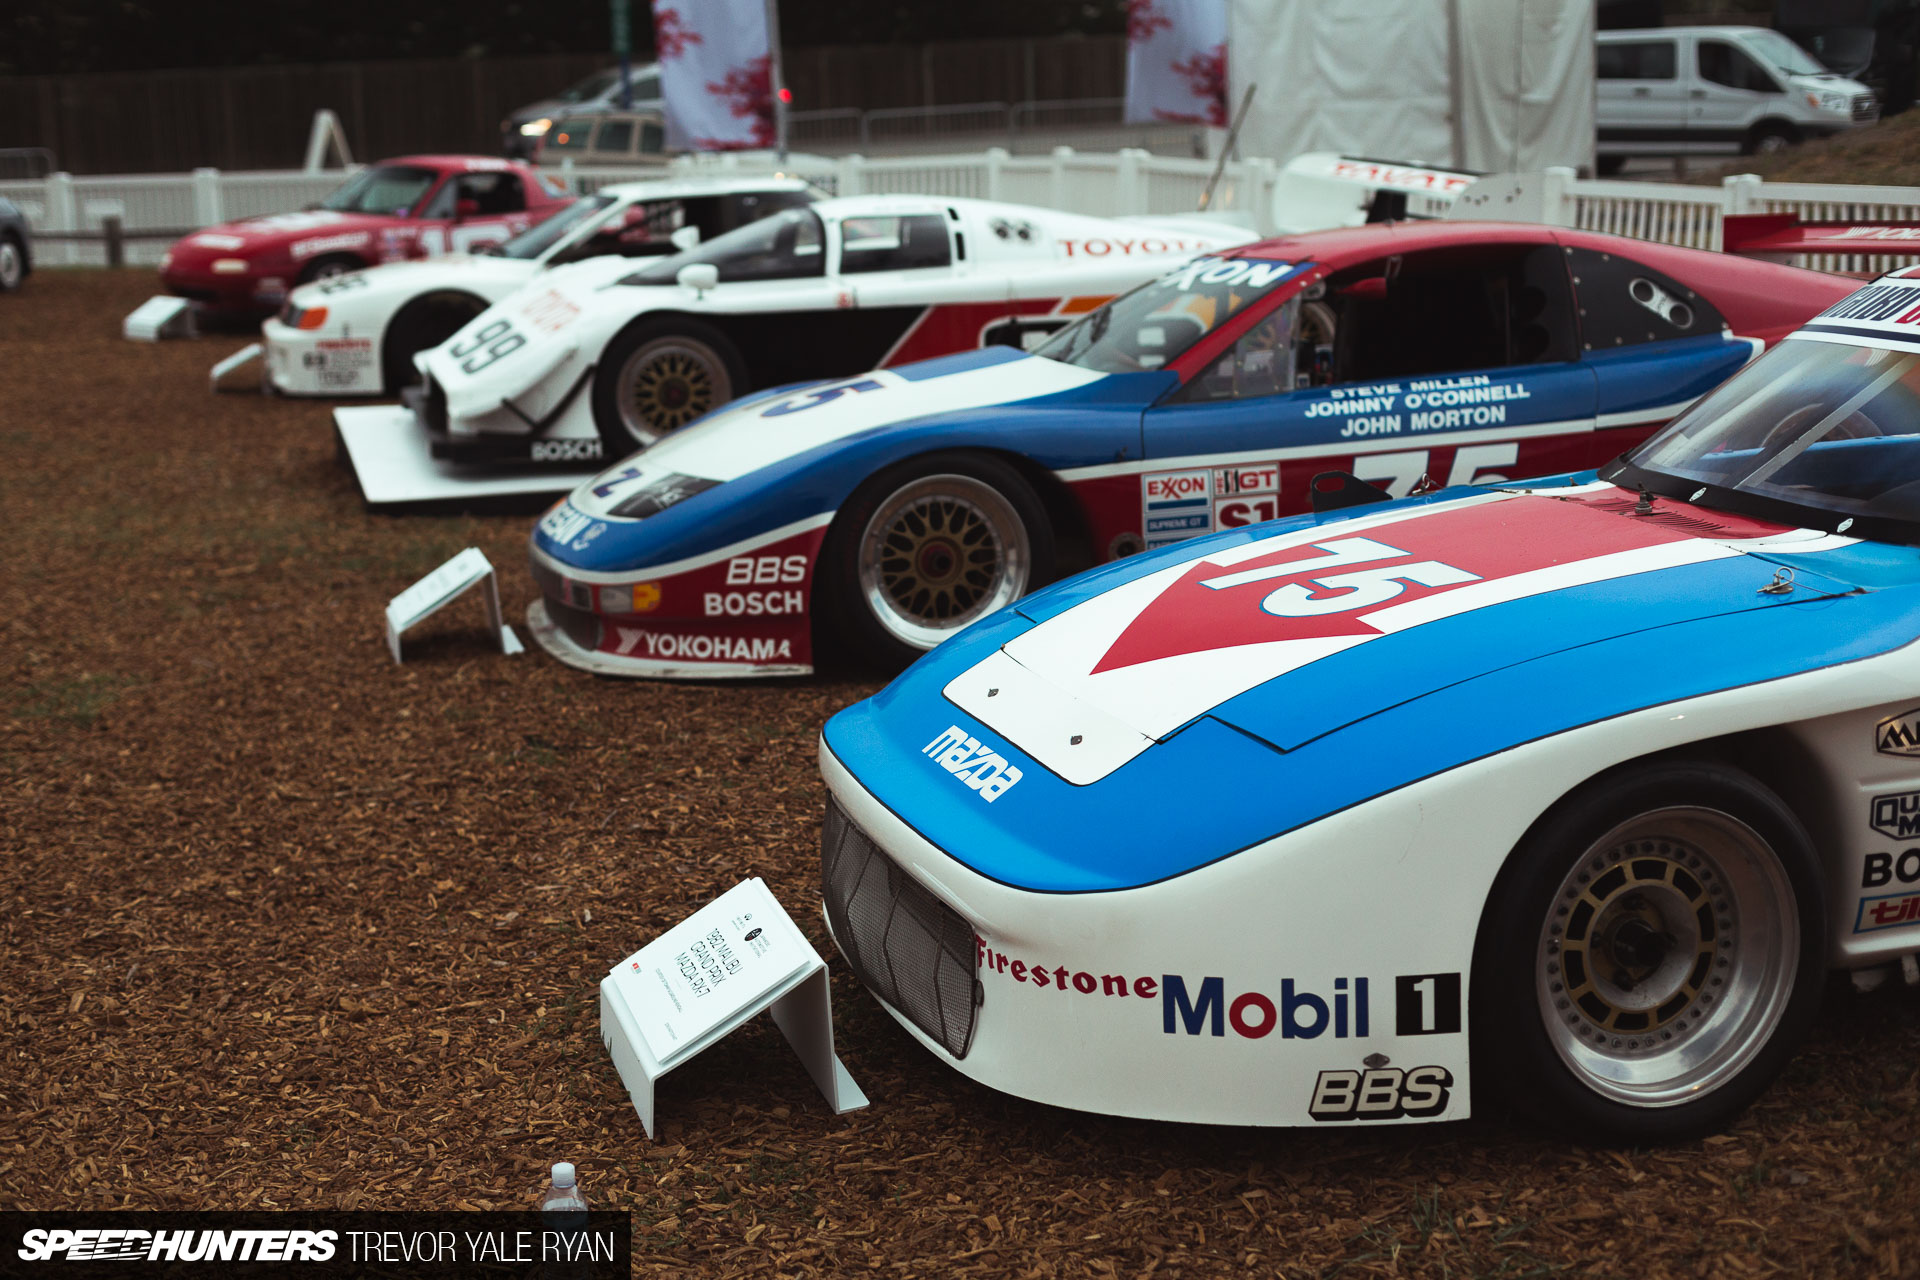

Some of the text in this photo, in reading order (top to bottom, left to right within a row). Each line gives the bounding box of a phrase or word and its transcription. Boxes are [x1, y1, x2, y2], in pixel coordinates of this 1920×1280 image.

[450, 320, 527, 374] 99
[1305, 384, 1531, 418] JOHNNY O'CONNELL
[1330, 375, 1490, 399] STEVE MILLEN
[1340, 405, 1506, 437] JOHN MORTON
[531, 441, 602, 461] BOSCH
[1148, 477, 1205, 499] EXXON
[1239, 470, 1277, 489] GT
[1218, 501, 1274, 527] S1
[726, 555, 808, 585] BBS
[1199, 537, 1484, 618] 75
[704, 590, 803, 616] BOSCH
[645, 633, 792, 660] YOKOHAMA
[706, 928, 725, 949] 1982
[674, 951, 700, 984] MAZDA
[690, 940, 727, 988] GRAND PRIX
[715, 943, 744, 975] MALIBU
[976, 934, 1158, 999] Firestone
[1162, 974, 1369, 1040] Mobil
[1309, 1065, 1454, 1122] BBS
